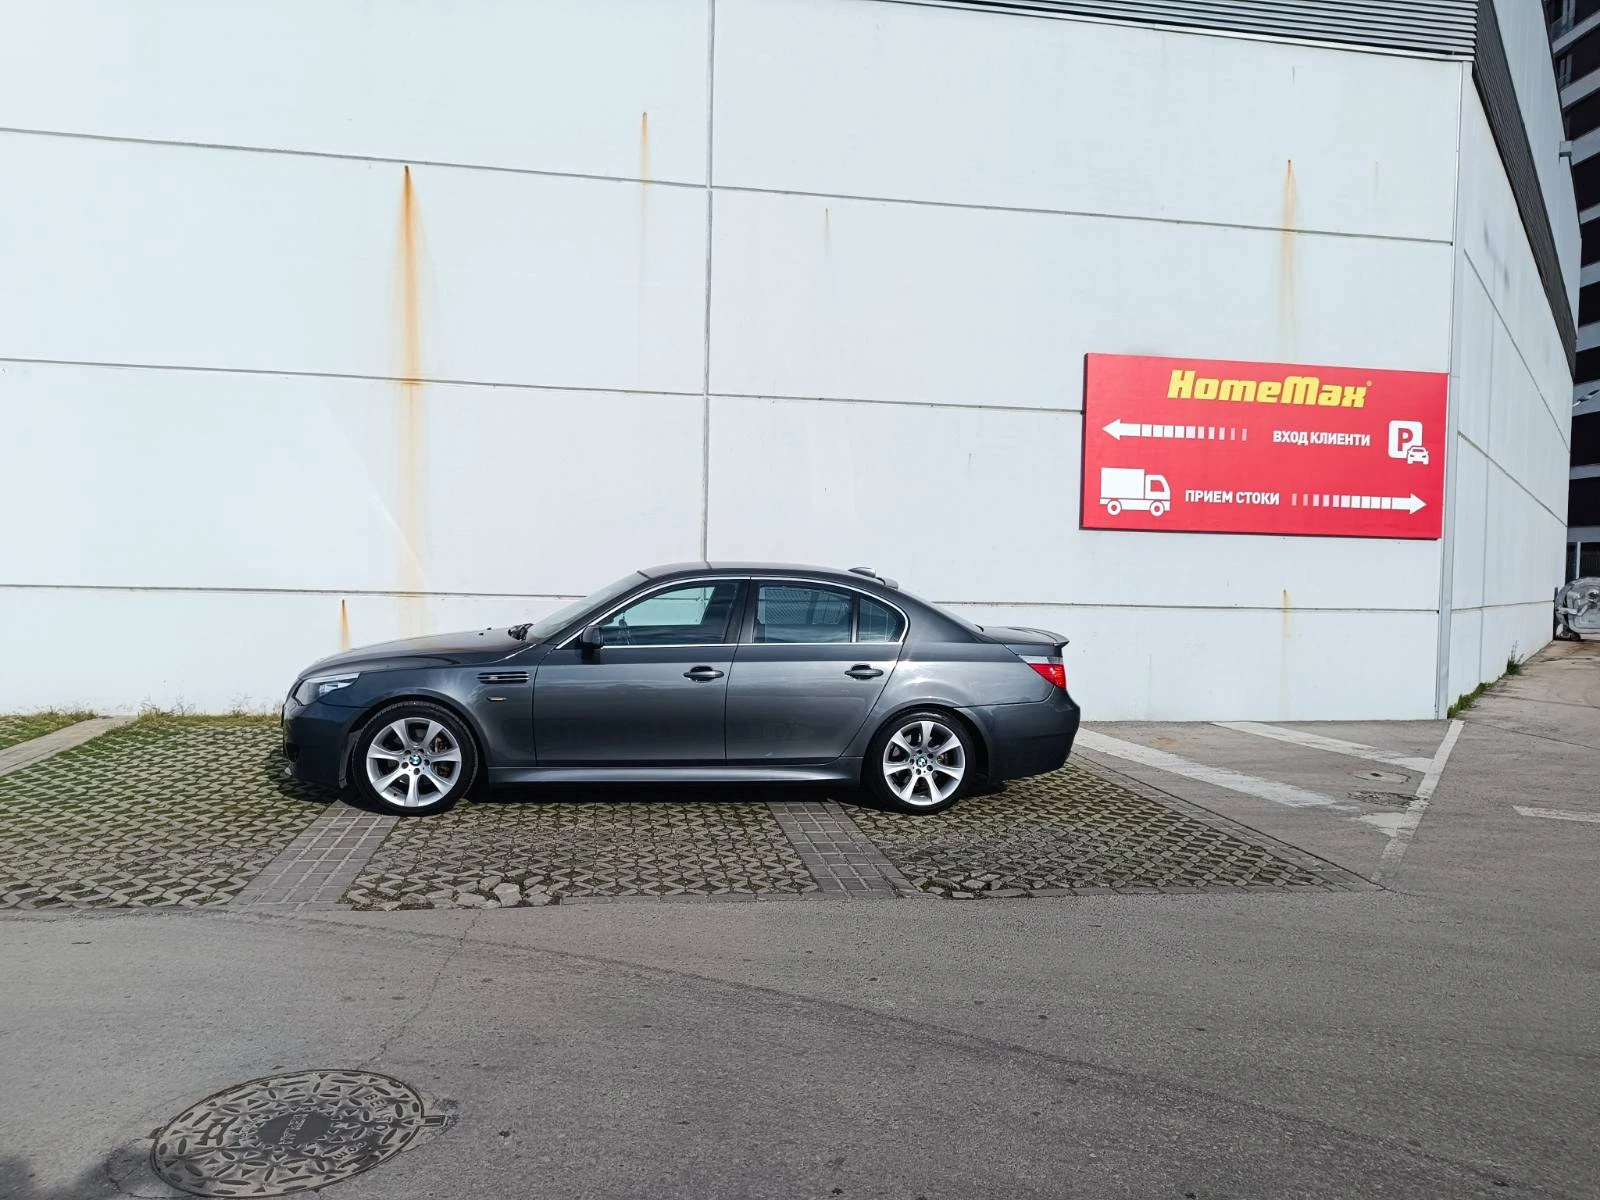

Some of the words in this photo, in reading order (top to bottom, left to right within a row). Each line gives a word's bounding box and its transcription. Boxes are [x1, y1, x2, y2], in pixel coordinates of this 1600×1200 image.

[1167, 369, 1367, 408] HomeMax
[1273, 430, 1309, 446] ВХОД
[1310, 431, 1371, 447] КЛИЕНТИ
[1397, 427, 1414, 452] P
[1185, 489, 1233, 504] ПРИЕМ
[1235, 490, 1280, 506] СТОКИ
